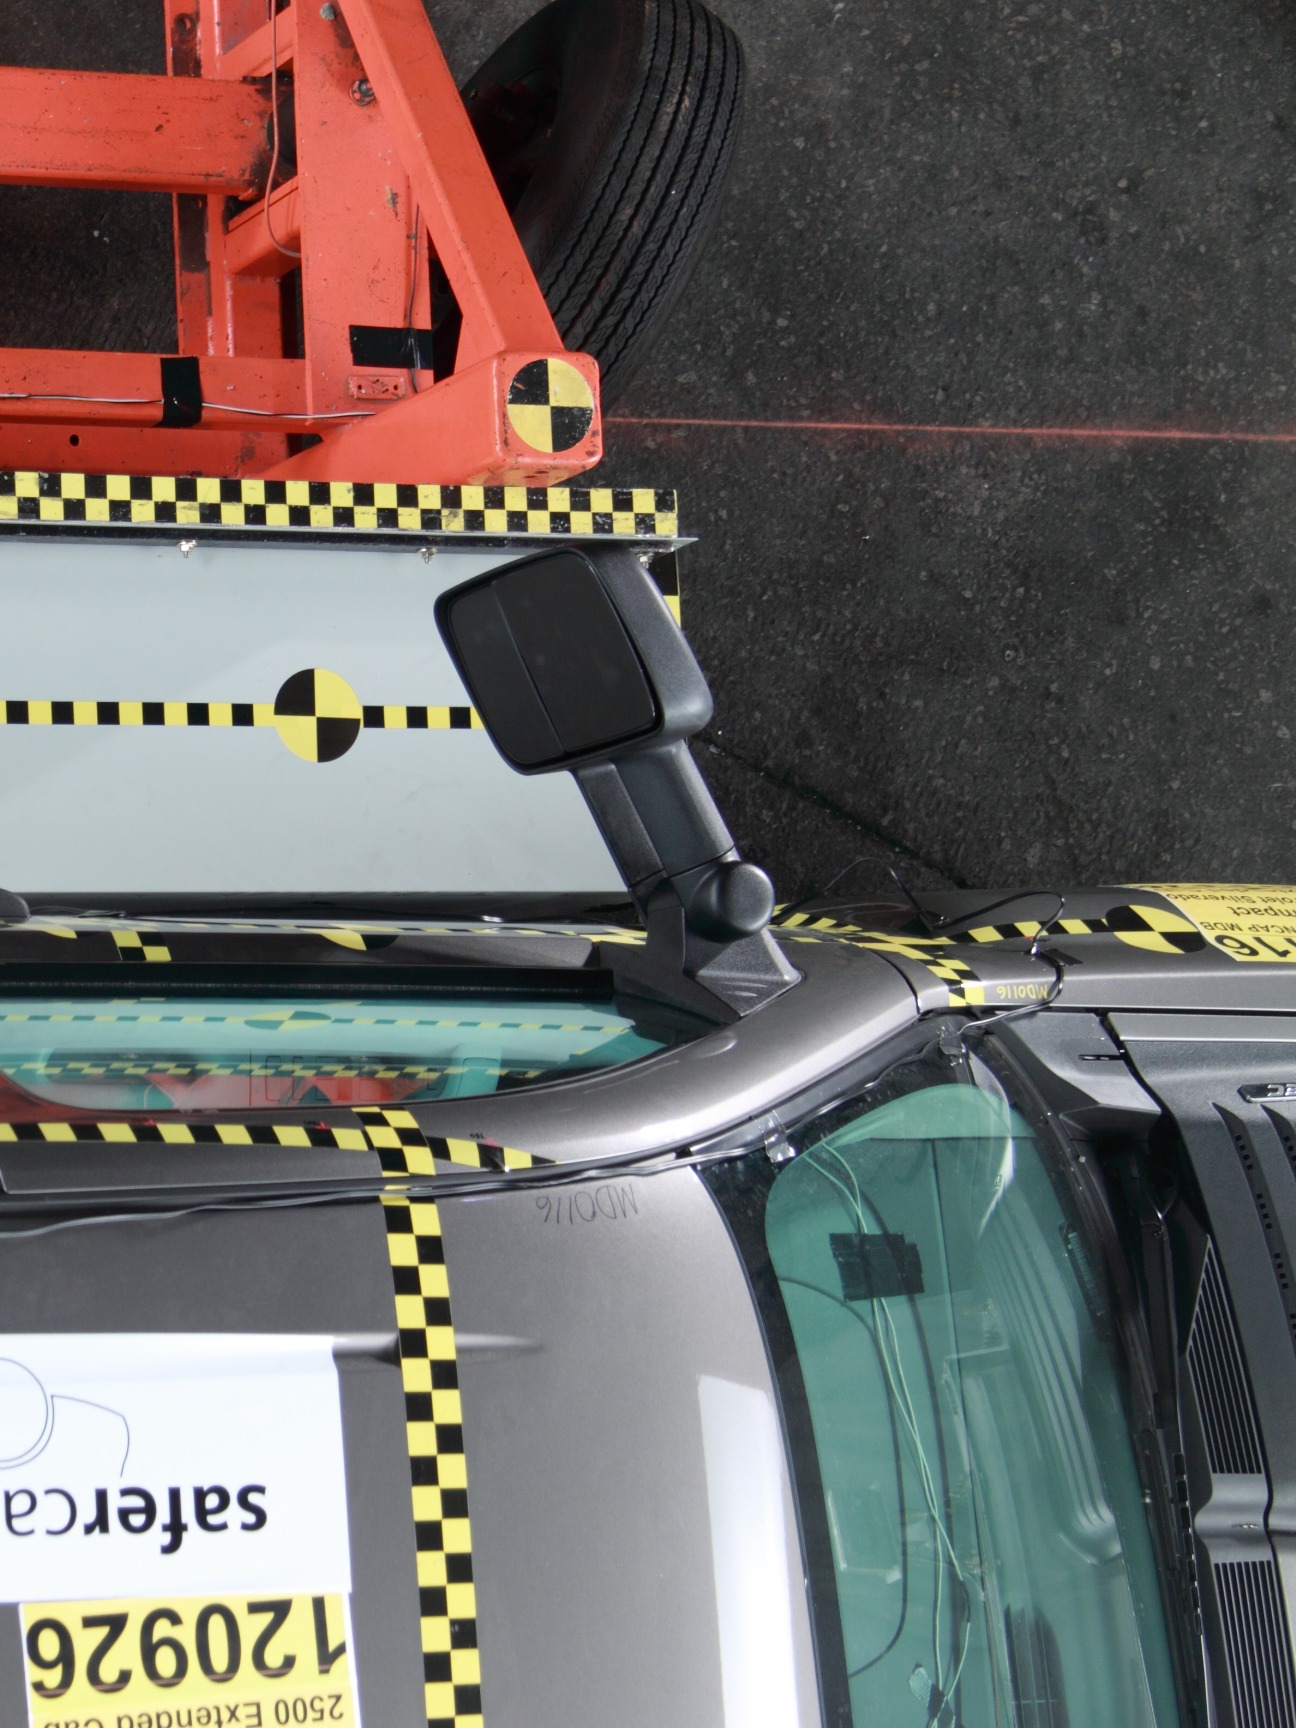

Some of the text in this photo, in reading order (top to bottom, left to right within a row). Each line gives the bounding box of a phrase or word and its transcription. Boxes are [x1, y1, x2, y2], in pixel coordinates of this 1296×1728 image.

[1166, 893, 1256, 904] Silverado
[1200, 921, 1243, 932] MDB
[26, 1596, 347, 1699] 120926
[117, 1693, 344, 1728] 2500 Extended
